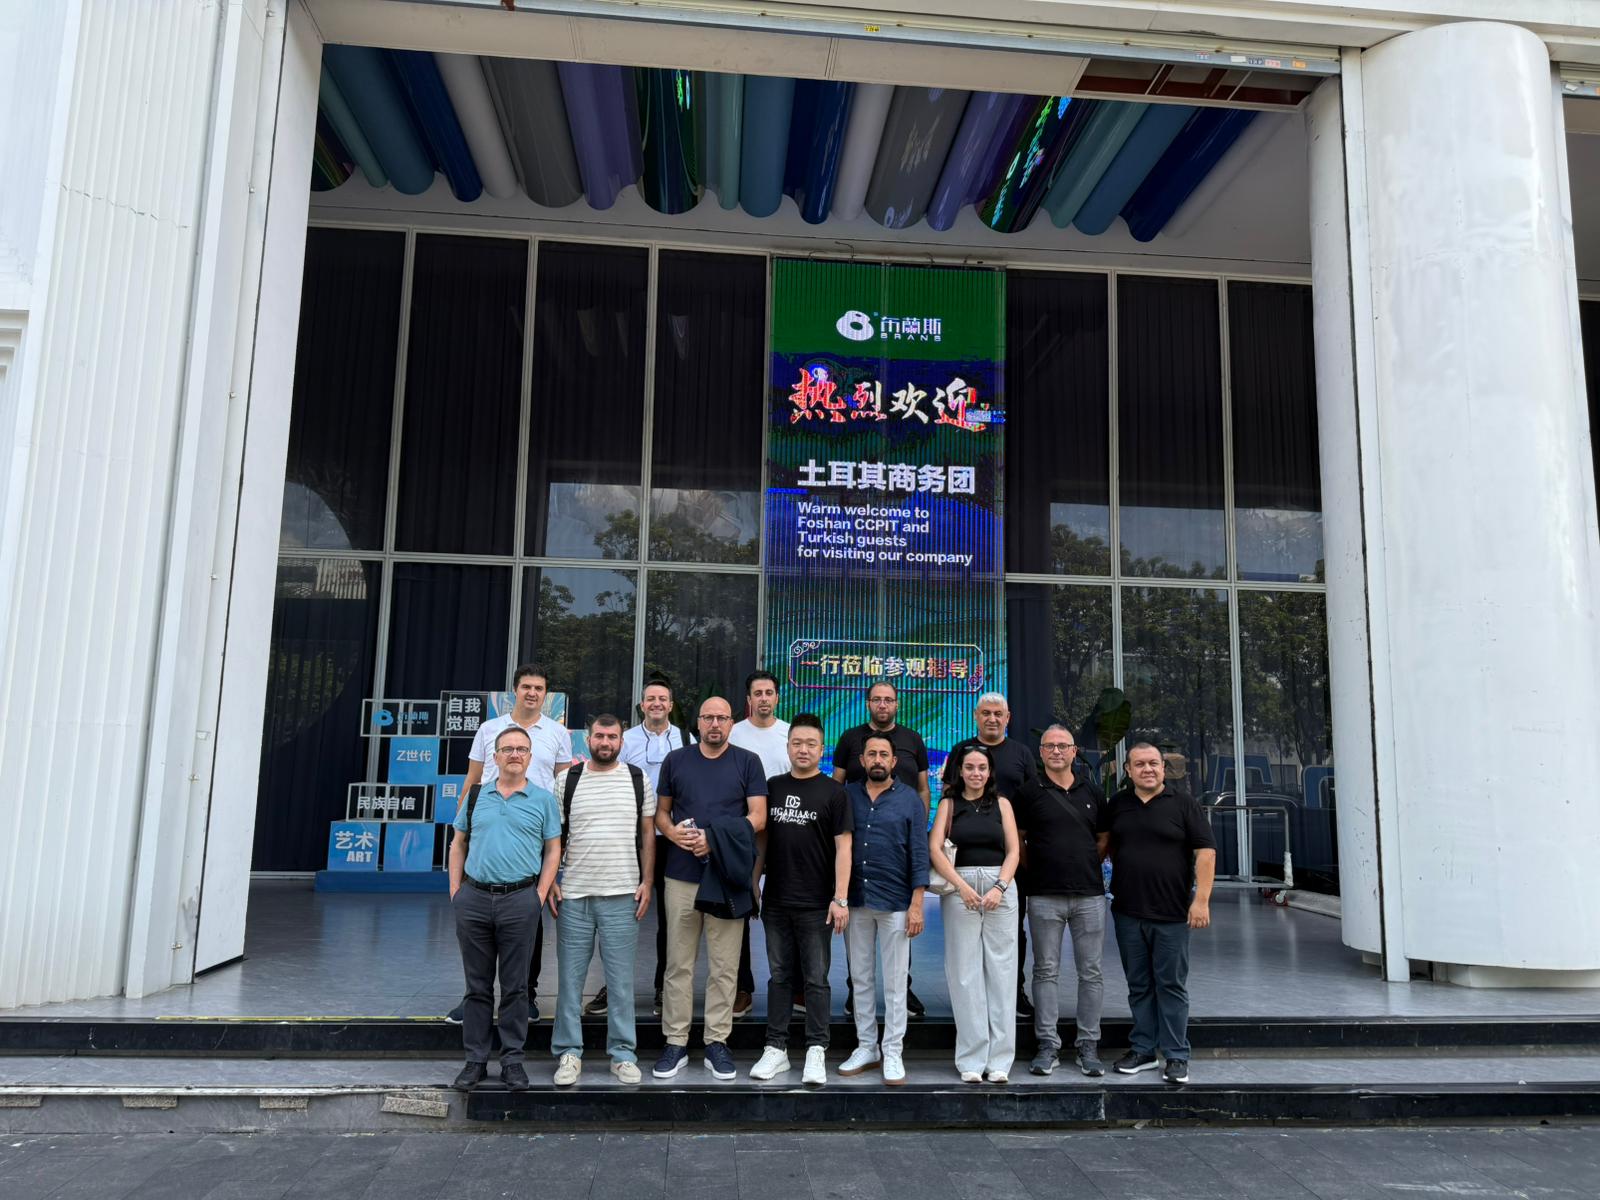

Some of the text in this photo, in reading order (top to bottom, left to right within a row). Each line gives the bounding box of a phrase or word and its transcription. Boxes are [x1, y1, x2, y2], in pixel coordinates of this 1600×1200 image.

[797, 459, 976, 494] 土耳其商务团
[798, 502, 930, 519] Warm welcome to
[797, 516, 930, 533] Foshan CCPIT and
[797, 531, 907, 548] Turkish guests
[797, 545, 973, 566] for visiting our company
[448, 697, 482, 713] 自我
[446, 715, 481, 731] 觉醒
[396, 749, 432, 762] Z世代
[358, 795, 416, 811] 民族自信
[335, 830, 374, 850] 艺术
[346, 850, 373, 863] ART
